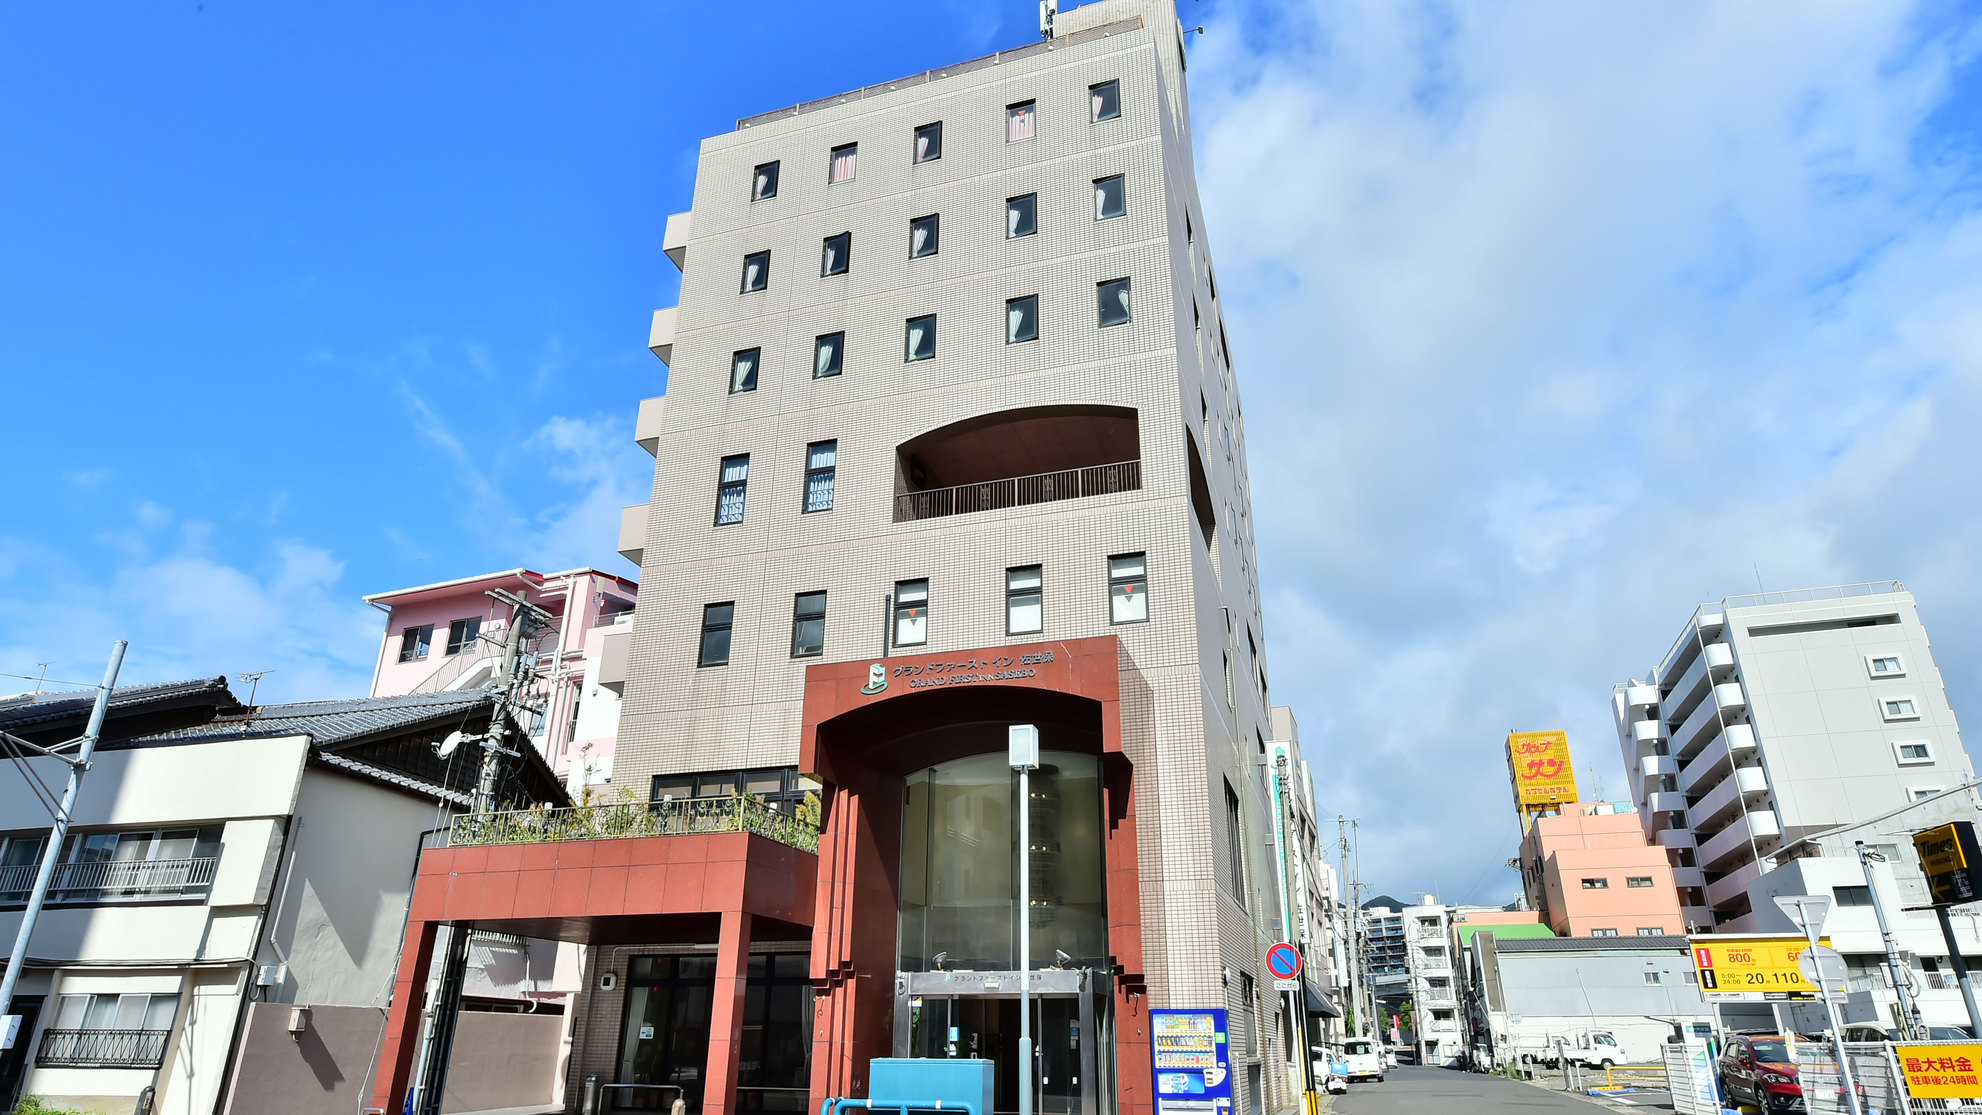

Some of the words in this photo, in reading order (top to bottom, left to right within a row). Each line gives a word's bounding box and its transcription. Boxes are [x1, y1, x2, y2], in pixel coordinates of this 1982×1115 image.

[893, 657, 988, 677] グランドファースト
[1019, 651, 1054, 666] 佐世保
[910, 676, 946, 688] GRAND
[949, 673, 979, 685] FIRST
[979, 673, 994, 683] INN
[995, 668, 1036, 681] SASEBO
[1920, 838, 1953, 858] Times
[1905, 1056, 1974, 1073] 最大料金
[1910, 1075, 1979, 1086] 駐車後24時間
